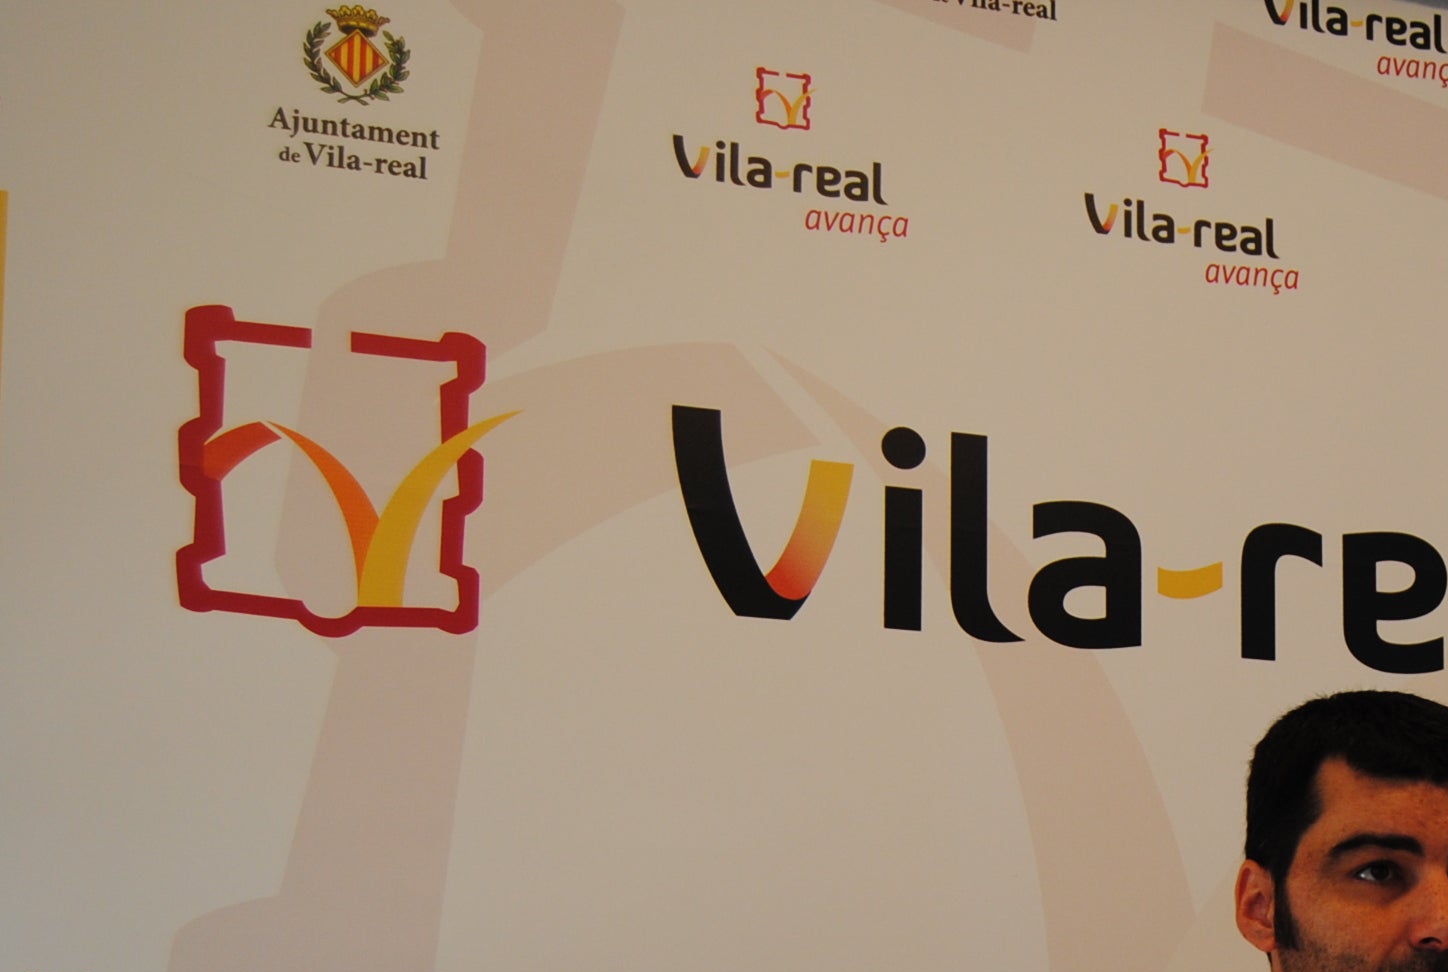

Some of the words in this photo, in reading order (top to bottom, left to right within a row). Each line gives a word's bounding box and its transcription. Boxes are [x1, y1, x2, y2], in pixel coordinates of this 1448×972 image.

[955, 0, 1058, 21] a-real
[1263, 0, 1447, 54] Vila-real
[268, 106, 439, 151] Ajuntament
[278, 146, 301, 164] de
[303, 141, 427, 180] Vila-real
[672, 134, 887, 206] Vila-real
[804, 209, 909, 244] avança
[1084, 192, 1279, 260] Vila-real
[1204, 263, 1300, 296] avança
